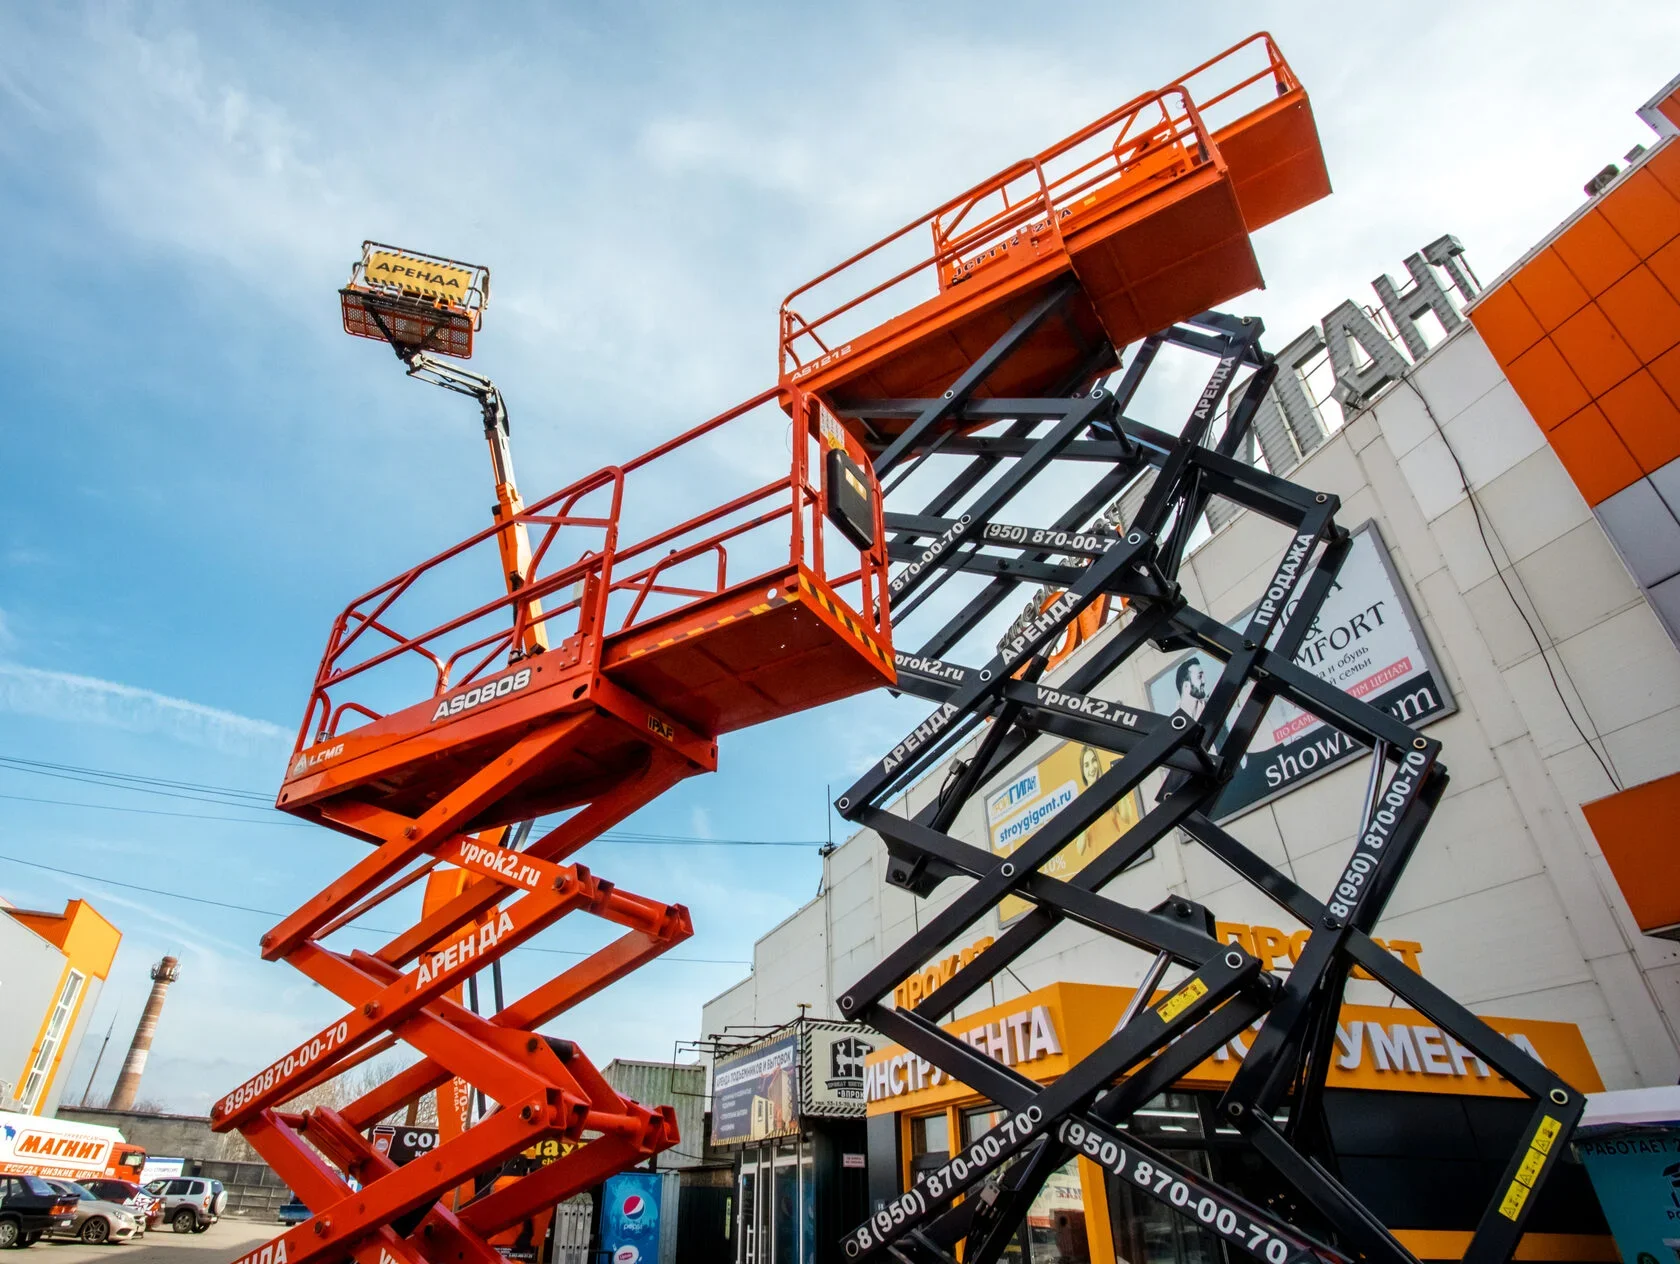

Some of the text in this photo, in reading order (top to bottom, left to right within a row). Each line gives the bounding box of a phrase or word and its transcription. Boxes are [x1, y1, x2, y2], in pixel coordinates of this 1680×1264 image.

[376, 262, 460, 288] АРЕНДА
[1194, 355, 1237, 421] АРЕНДА
[891, 522, 965, 591] 870-00-70
[983, 523, 1120, 552] (950) 870-00-7
[1254, 533, 1315, 626] ПРОДАЖА
[1000, 590, 1082, 665] АРЕНДА
[1293, 601, 1385, 668] MFORT
[895, 654, 965, 681] prok2.ru
[1337, 647, 1370, 670] обувь
[1338, 658, 1372, 682] семьи
[1370, 660, 1409, 688] ЦЕНАМ
[431, 668, 532, 723] AS0808
[1036, 686, 1138, 727] vprok2.ru
[882, 703, 960, 774] АРЕНДА
[1000, 790, 1071, 843] stroygigant.ru
[1329, 751, 1426, 918] 8(950) 870-00-70
[460, 841, 541, 887] vprok2.ru
[416, 912, 514, 991] АРЕНДА
[894, 936, 995, 1010] ПРОК
[224, 1021, 348, 1116] 8950870-00-70
[863, 1005, 1063, 1102] ИНСТРЕНТА
[18, 1135, 105, 1159] МАГНИТ
[41, 1167, 75, 1178] НИЗКИЕ
[1584, 1139, 1667, 1156] РАБОТАЕТ
[856, 1113, 1033, 1249] 8(950) 870-00-70
[1059, 1118, 1288, 1264] (950) 870-00-70
